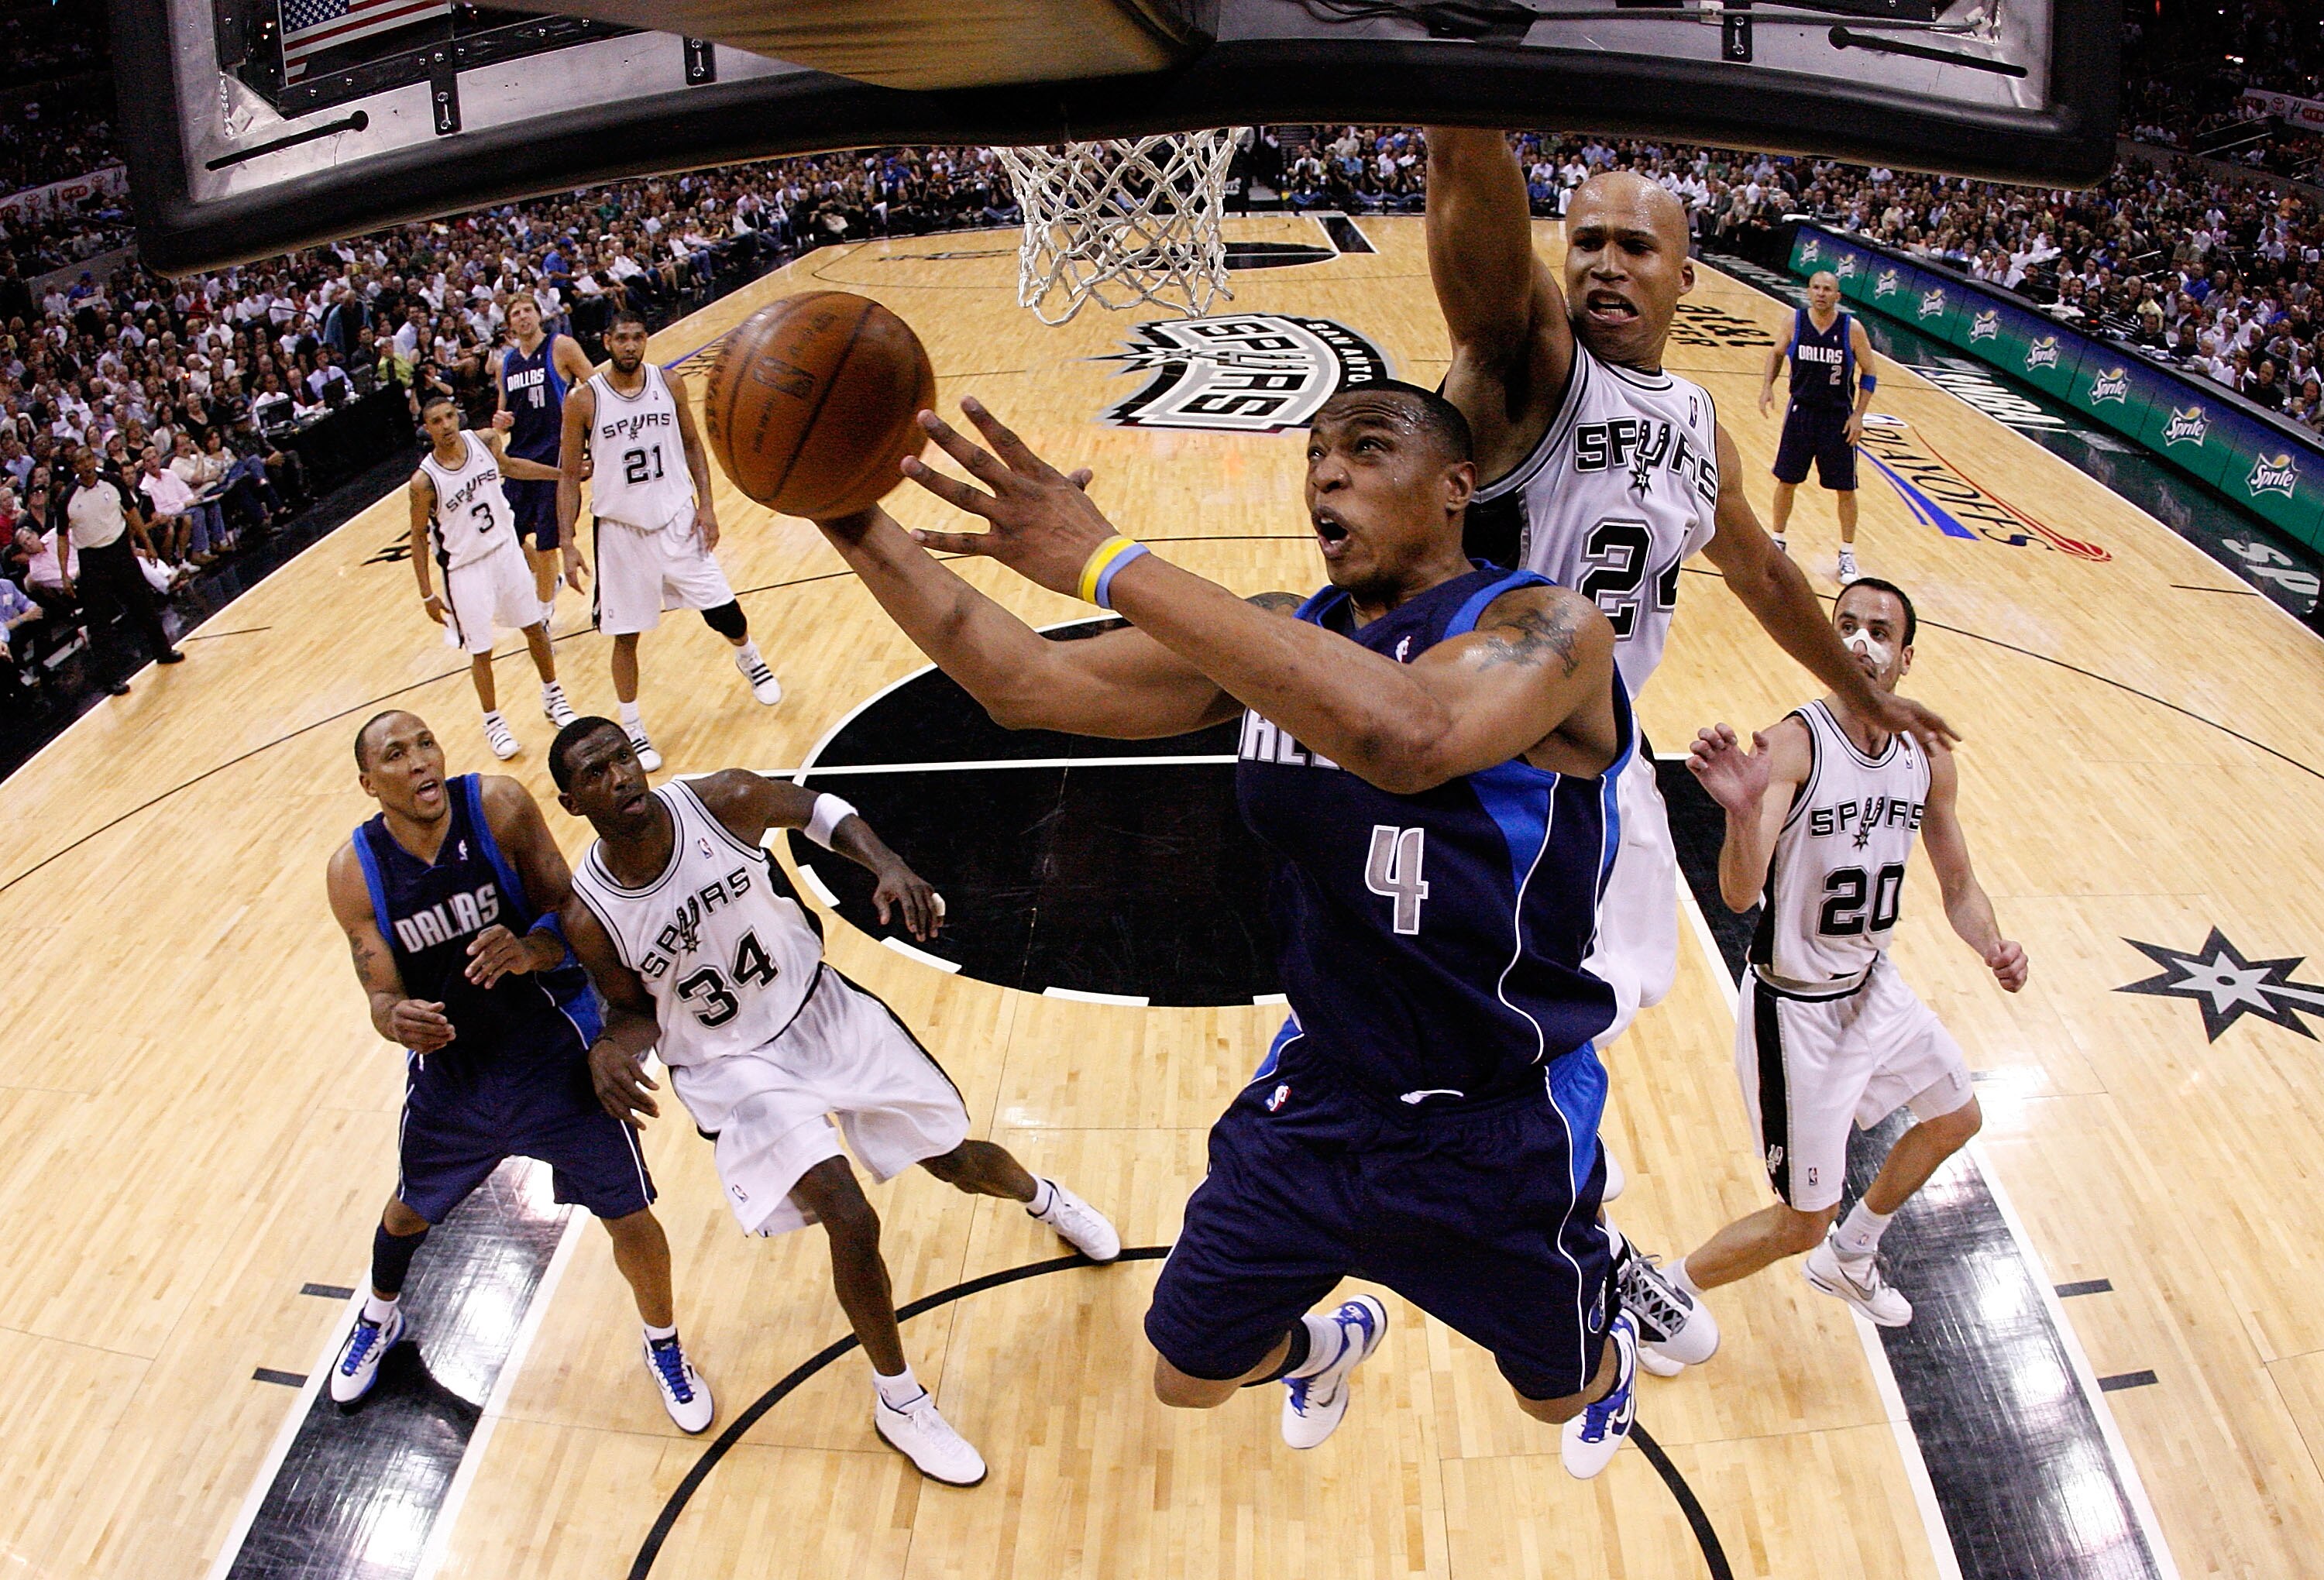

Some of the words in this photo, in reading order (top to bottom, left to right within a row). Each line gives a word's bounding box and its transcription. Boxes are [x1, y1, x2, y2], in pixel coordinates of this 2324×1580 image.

[1306, 323, 1353, 346] SAN
[1342, 348, 1373, 387] ANTO
[1798, 345, 1843, 364] DALLAS
[1830, 366, 1842, 385] 2
[507, 368, 545, 392] DALLAS
[528, 385, 545, 409] 41
[2092, 378, 2126, 399] Sprite
[603, 413, 671, 440] SPURS
[2165, 417, 2204, 439] Sprite
[623, 445, 665, 488] 21
[1573, 416, 1718, 511] SPURS
[2250, 465, 2294, 490] Sprite
[445, 469, 497, 513] SPURS
[1858, 427, 2055, 551] PLAYOFFS
[471, 502, 495, 534] 3
[1809, 795, 1924, 851] SPURS
[1364, 824, 1429, 935] 4
[1816, 860, 1906, 939] 20
[640, 866, 751, 979] SPURS
[675, 928, 780, 1030] 34
